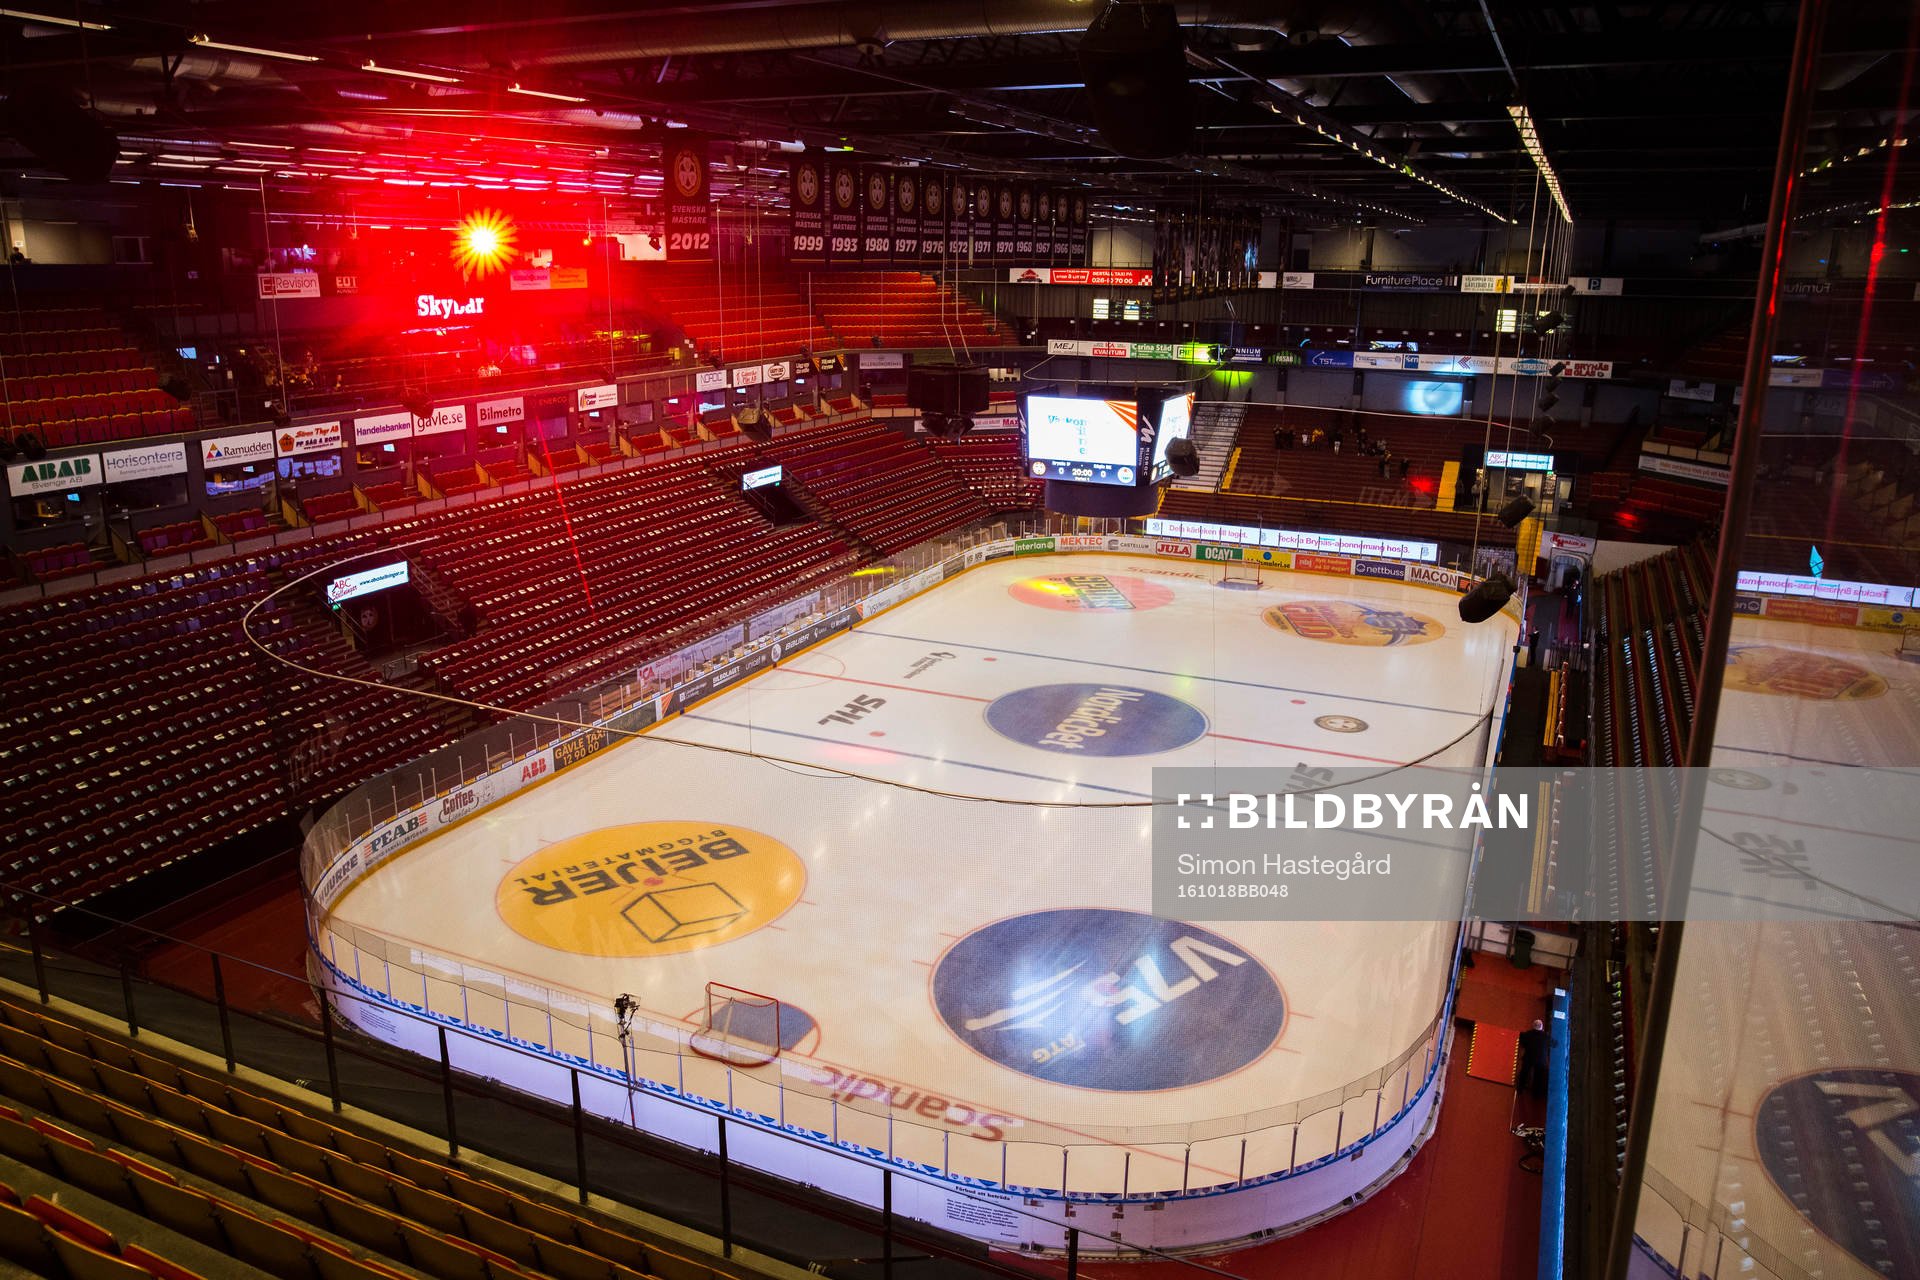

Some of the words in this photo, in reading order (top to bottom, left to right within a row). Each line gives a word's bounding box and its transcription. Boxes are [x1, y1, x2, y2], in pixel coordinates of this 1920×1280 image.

[672, 205, 706, 213] SVENSKA
[670, 233, 710, 250] 2012
[793, 236, 823, 251] 1999
[832, 237, 858, 252] 1993
[865, 238, 889, 252] 1980
[895, 239, 917, 252] 1977
[922, 240, 943, 253] 1976
[949, 241, 968, 254] 1972
[974, 240, 991, 253] 1971
[996, 241, 1014, 254] 1970
[1016, 240, 1032, 253] 1968
[1036, 242, 1050, 254] 1967
[1365, 275, 1443, 286] FurniturePlace
[1053, 342, 1074, 350] MEJ
[1574, 362, 1608, 371] BRYNÄS
[1574, 369, 1596, 377] GLAS
[480, 406, 522, 421] Bilmetro
[356, 421, 411, 437] Handelsbanken
[224, 442, 272, 457] Ramudden
[107, 450, 183, 470] Horisonterra
[22, 458, 91, 483] ABAB
[1072, 468, 1093, 477] 20:00
[32, 479, 67, 489] Sverige
[69, 476, 83, 484] AB
[1060, 537, 1102, 545] MEKTEC
[1158, 544, 1190, 555] JULA
[1128, 566, 1205, 580] Scandic
[1366, 566, 1404, 577] nettbuss
[1411, 567, 1457, 586] MACON
[334, 578, 351, 590] ABC
[745, 655, 761, 670] unicef
[818, 694, 886, 726] SHL
[1038, 687, 1145, 749] NordicBet
[555, 737, 584, 759] GÄVLE
[563, 755, 573, 766] 12
[574, 748, 586, 758] 90
[588, 742, 600, 753] 00
[522, 758, 547, 782] ABB
[442, 789, 474, 816] Coffee
[370, 816, 420, 854] PEAB
[514, 828, 727, 885] BYGGMATERIAL
[522, 838, 750, 906] BEIJER
[1089, 936, 1248, 1025] V75
[1032, 1033, 1084, 1064] ATG
[809, 1064, 1005, 1143] Scandic
